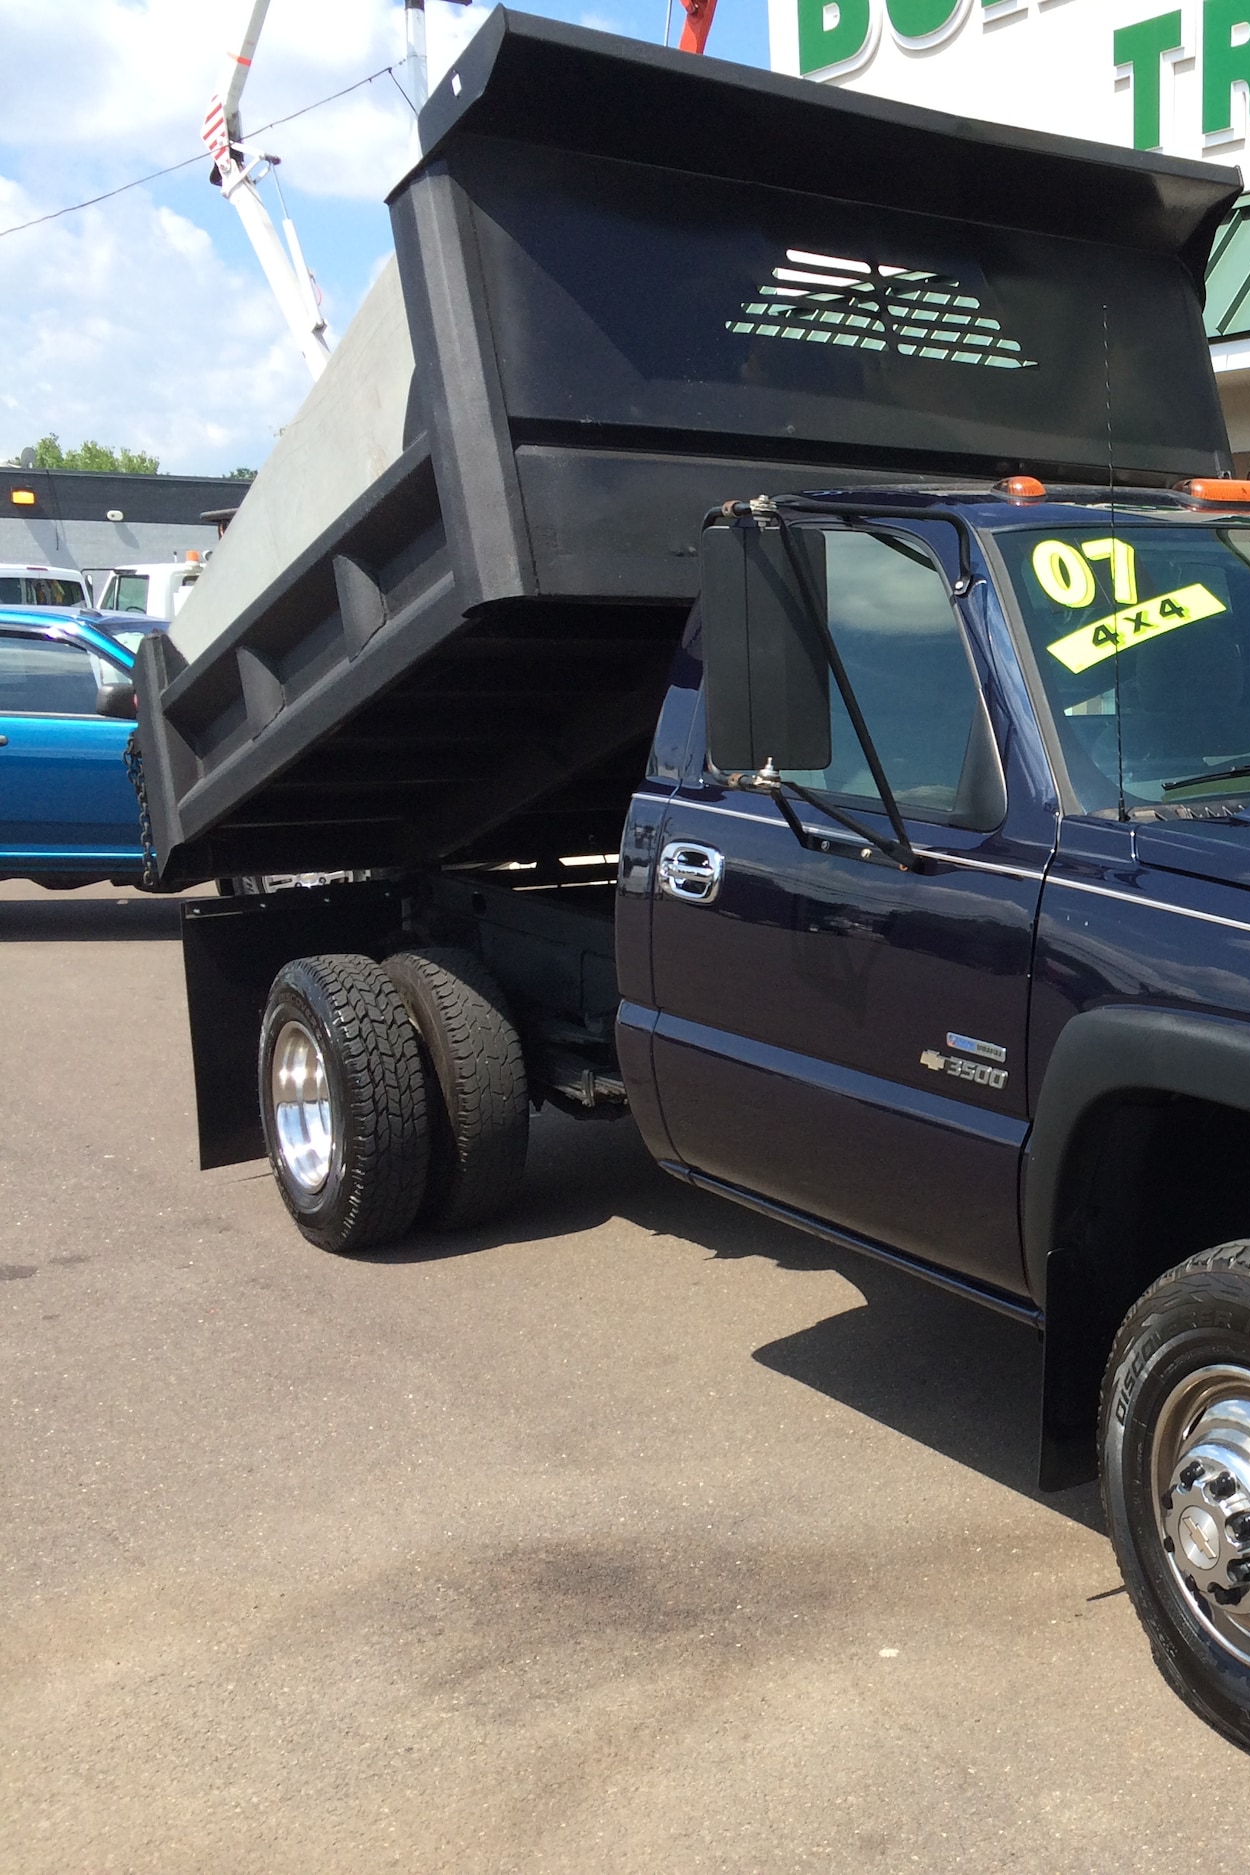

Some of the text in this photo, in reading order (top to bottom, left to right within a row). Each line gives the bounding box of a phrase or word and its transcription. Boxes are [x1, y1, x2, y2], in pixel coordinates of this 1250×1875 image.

[1032, 537, 1138, 609] 07
[947, 1056, 1008, 1089] 3500
[1115, 1310, 1233, 1426] DISCORER
